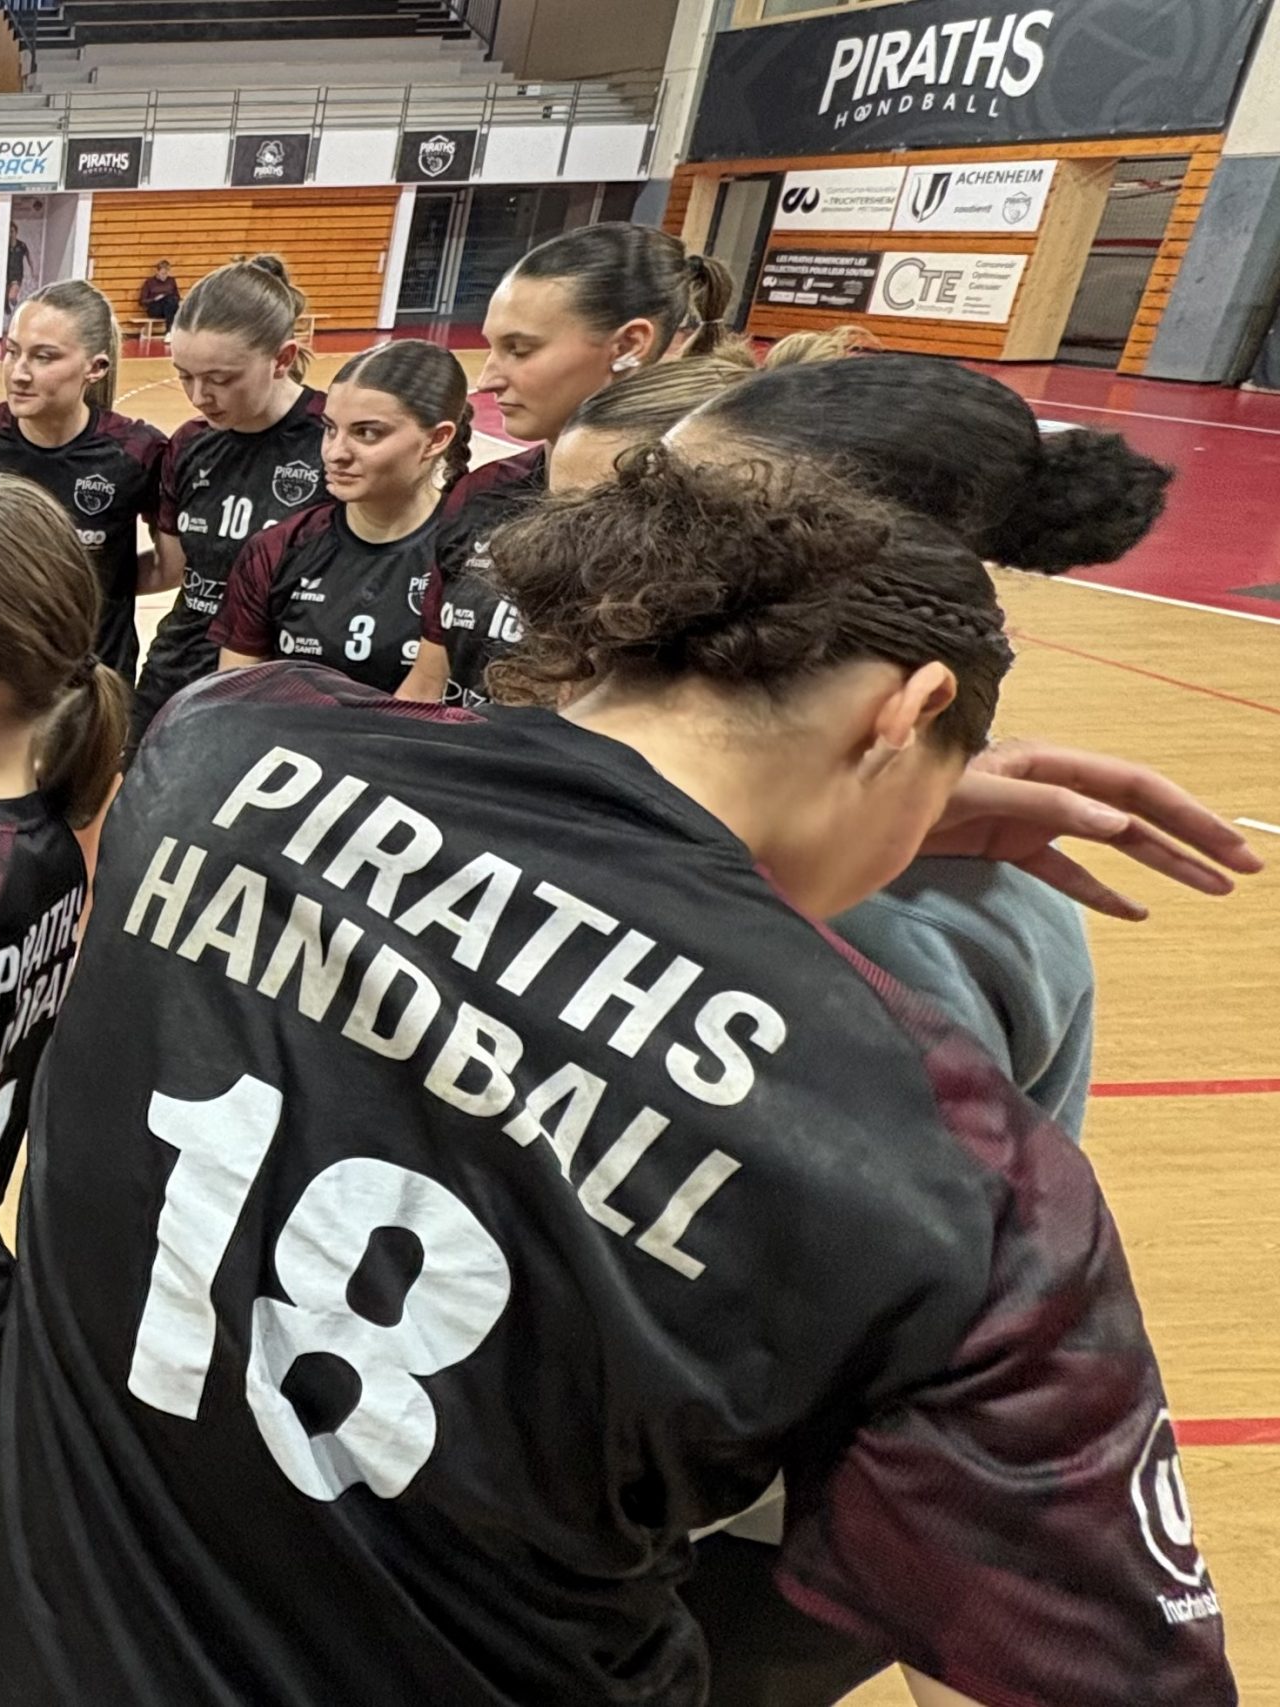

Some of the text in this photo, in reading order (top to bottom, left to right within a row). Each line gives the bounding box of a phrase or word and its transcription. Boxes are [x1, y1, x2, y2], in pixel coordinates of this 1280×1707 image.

[818, 9, 1055, 116] PIRATHS
[78, 152, 130, 171] PIRATHS
[420, 141, 456, 154] PIRATHS
[955, 168, 1044, 186] ACHENHEIM
[882, 257, 964, 311] CTE
[75, 478, 116, 496] PIRATHS
[274, 465, 319, 483] PIRATHS
[218, 494, 253, 540] 10
[344, 614, 376, 661] 3
[211, 746, 787, 1106] PIRATHS
[123, 836, 741, 1281] HANDBALL
[127, 1074, 511, 1502] 18
